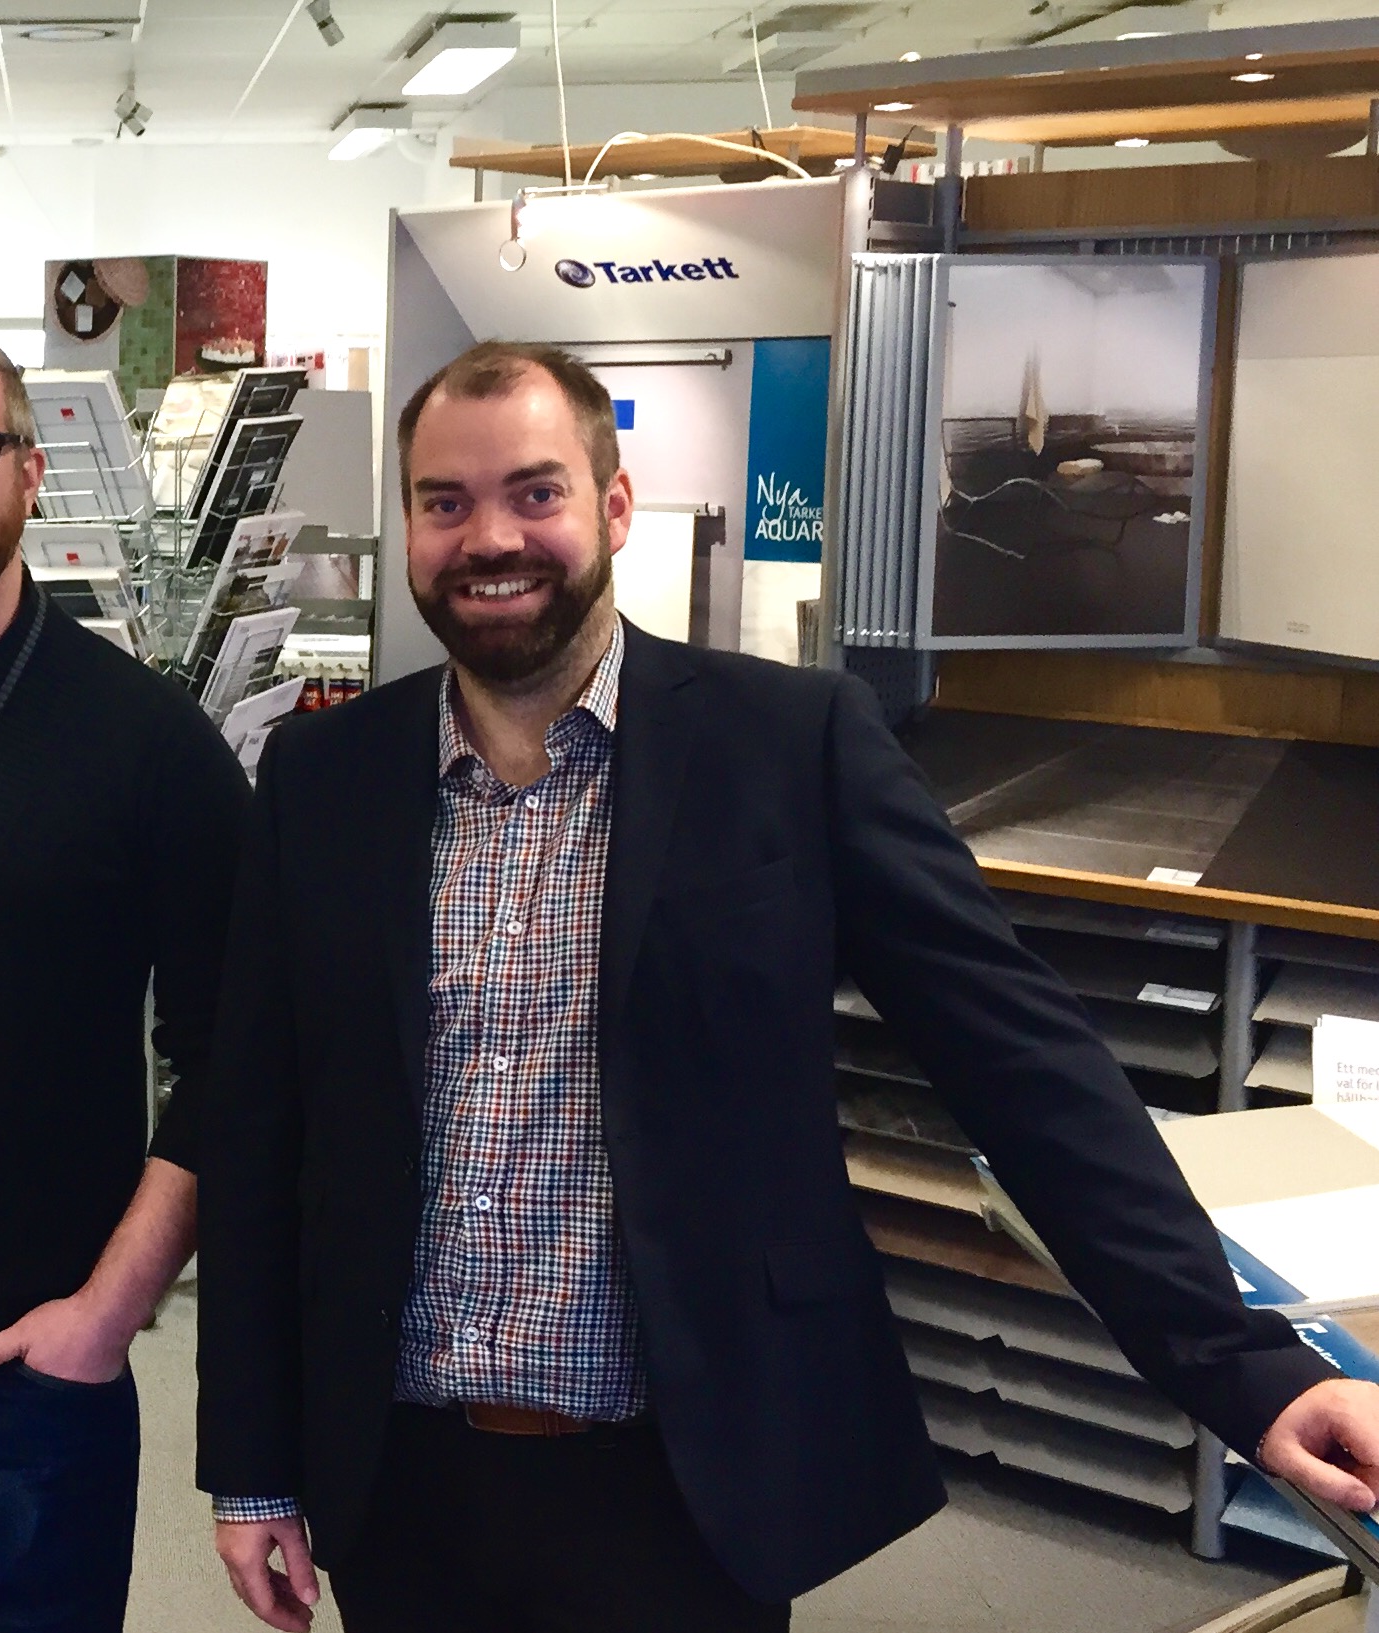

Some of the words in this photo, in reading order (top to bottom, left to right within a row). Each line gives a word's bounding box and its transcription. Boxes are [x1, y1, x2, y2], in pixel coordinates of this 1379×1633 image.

[594, 257, 739, 284] Tarkett
[757, 471, 809, 523] Nya
[788, 506, 823, 519] TARKE
[755, 518, 824, 541] AQUAR
[1337, 1062, 1353, 1074] Ett
[1336, 1078, 1354, 1089] val
[1356, 1078, 1373, 1090] för
